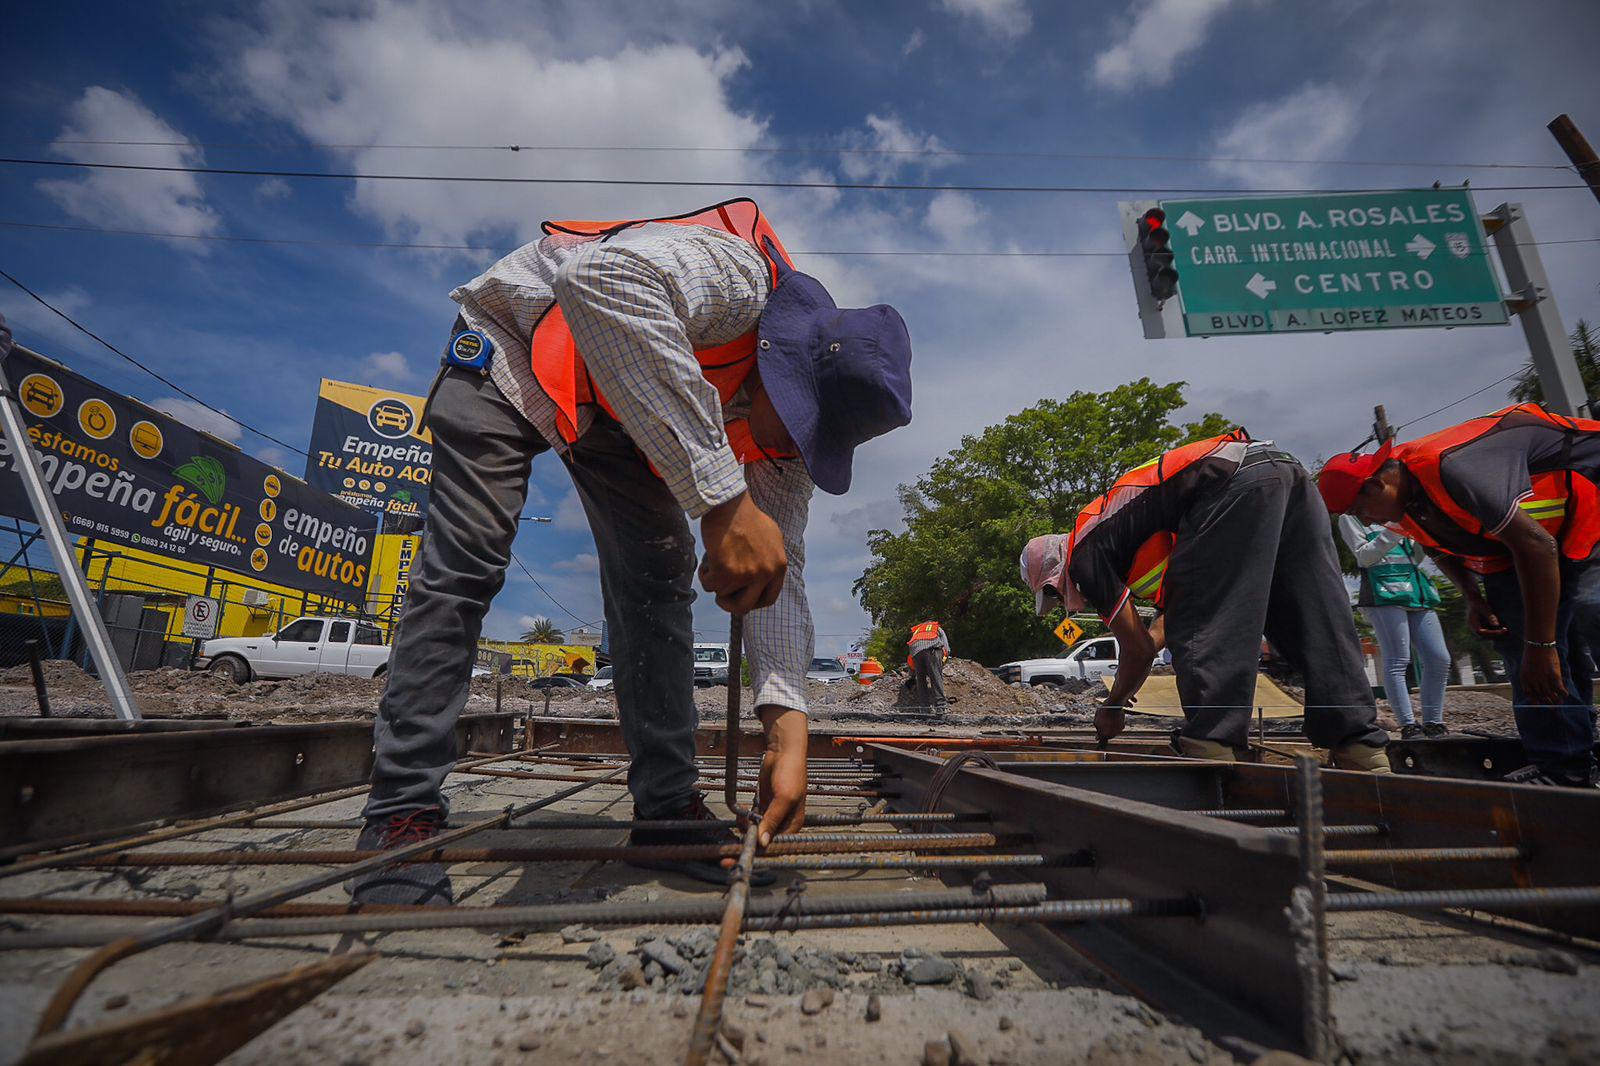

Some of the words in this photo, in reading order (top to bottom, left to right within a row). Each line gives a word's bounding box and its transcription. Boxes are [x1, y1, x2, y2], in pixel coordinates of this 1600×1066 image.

[1212, 212, 1286, 232] BLVD.
[1297, 210, 1323, 229] A.
[1328, 203, 1466, 228] ROSALES
[1191, 245, 1243, 265] CARR.
[1251, 238, 1396, 263] INTERNACIONAL
[1295, 270, 1434, 294] CENTRO
[1211, 314, 1274, 330] BLVD.
[1287, 313, 1307, 327] A.
[1320, 309, 1389, 326] LOPEZ
[1401, 306, 1483, 322] MATEOS
[342, 436, 432, 465] Empeña
[319, 451, 342, 470] Tu
[345, 456, 395, 478] Auto
[163, 523, 190, 541] ágil
[188, 532, 199, 546] y
[283, 508, 367, 556] empeño
[168, 543, 177, 552] 12
[279, 535, 299, 557] de
[297, 545, 366, 587] autos
